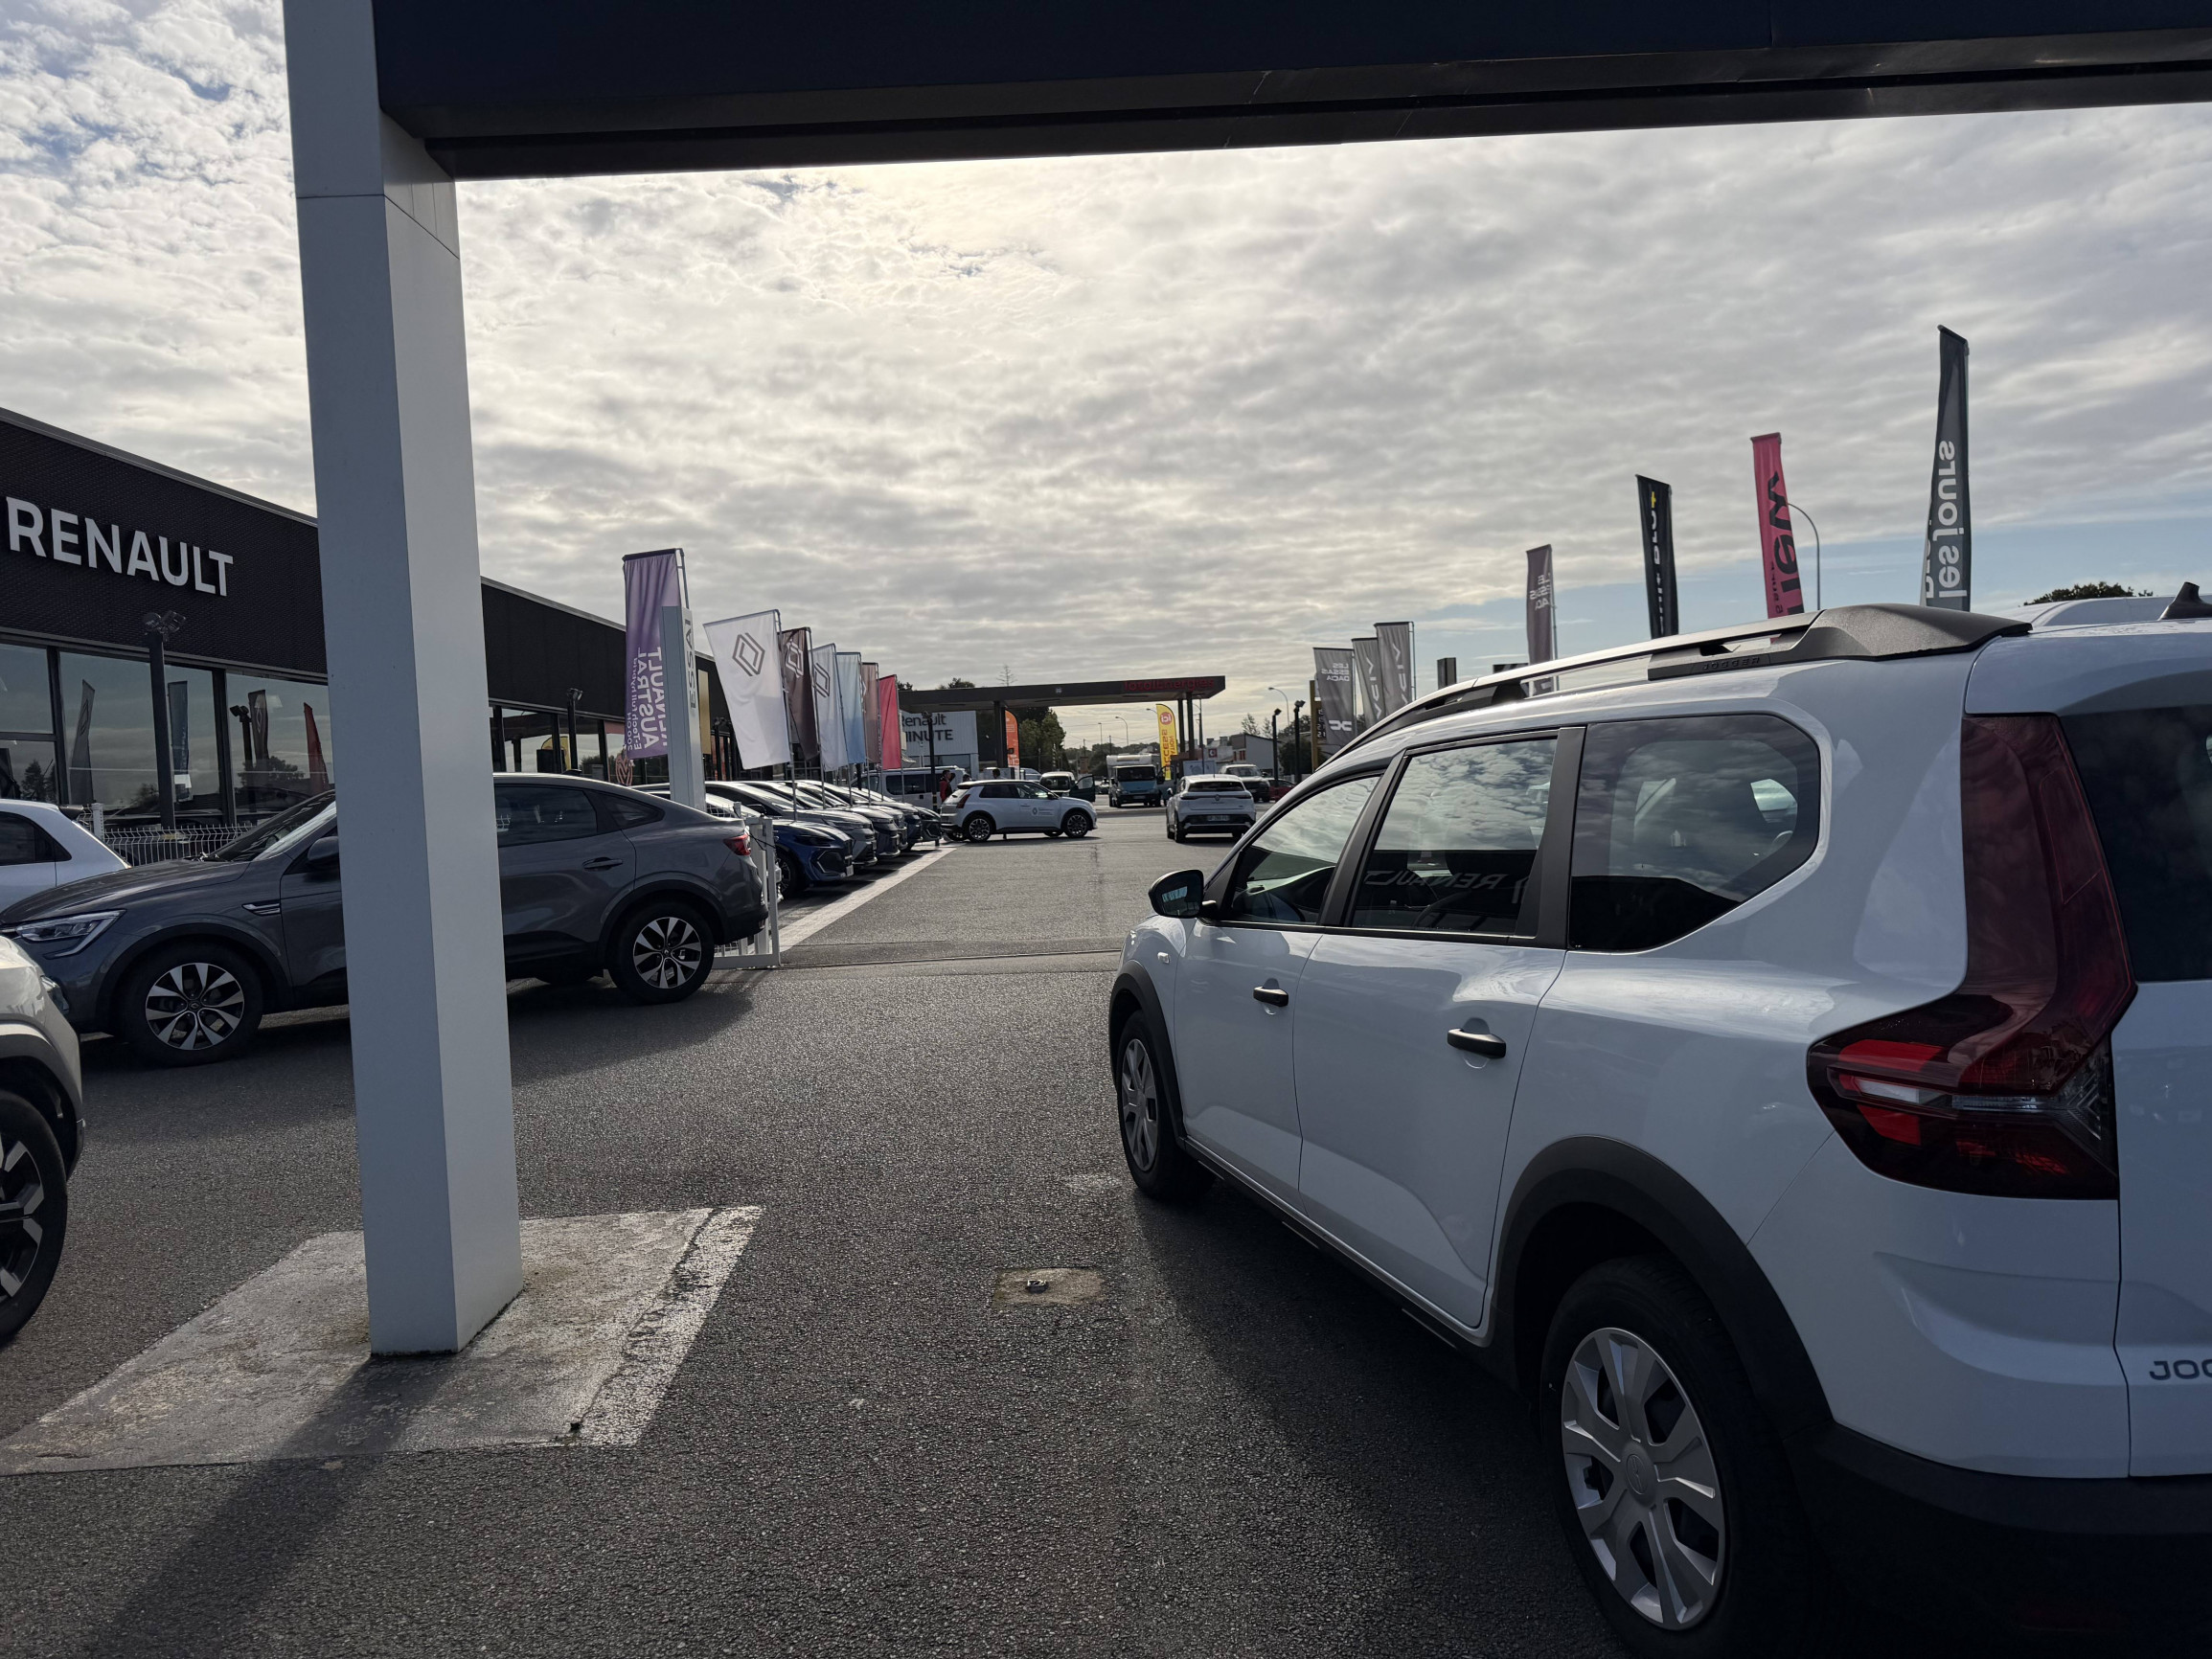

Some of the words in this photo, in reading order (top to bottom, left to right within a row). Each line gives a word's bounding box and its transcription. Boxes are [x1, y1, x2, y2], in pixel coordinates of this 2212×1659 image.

[6, 496, 234, 597] RENAULT
[684, 619, 696, 709] ESSAI
[1702, 656, 1760, 670] JOGGER
[1124, 678, 1215, 693] TotalEnergies
[906, 729, 953, 742] INUTE
